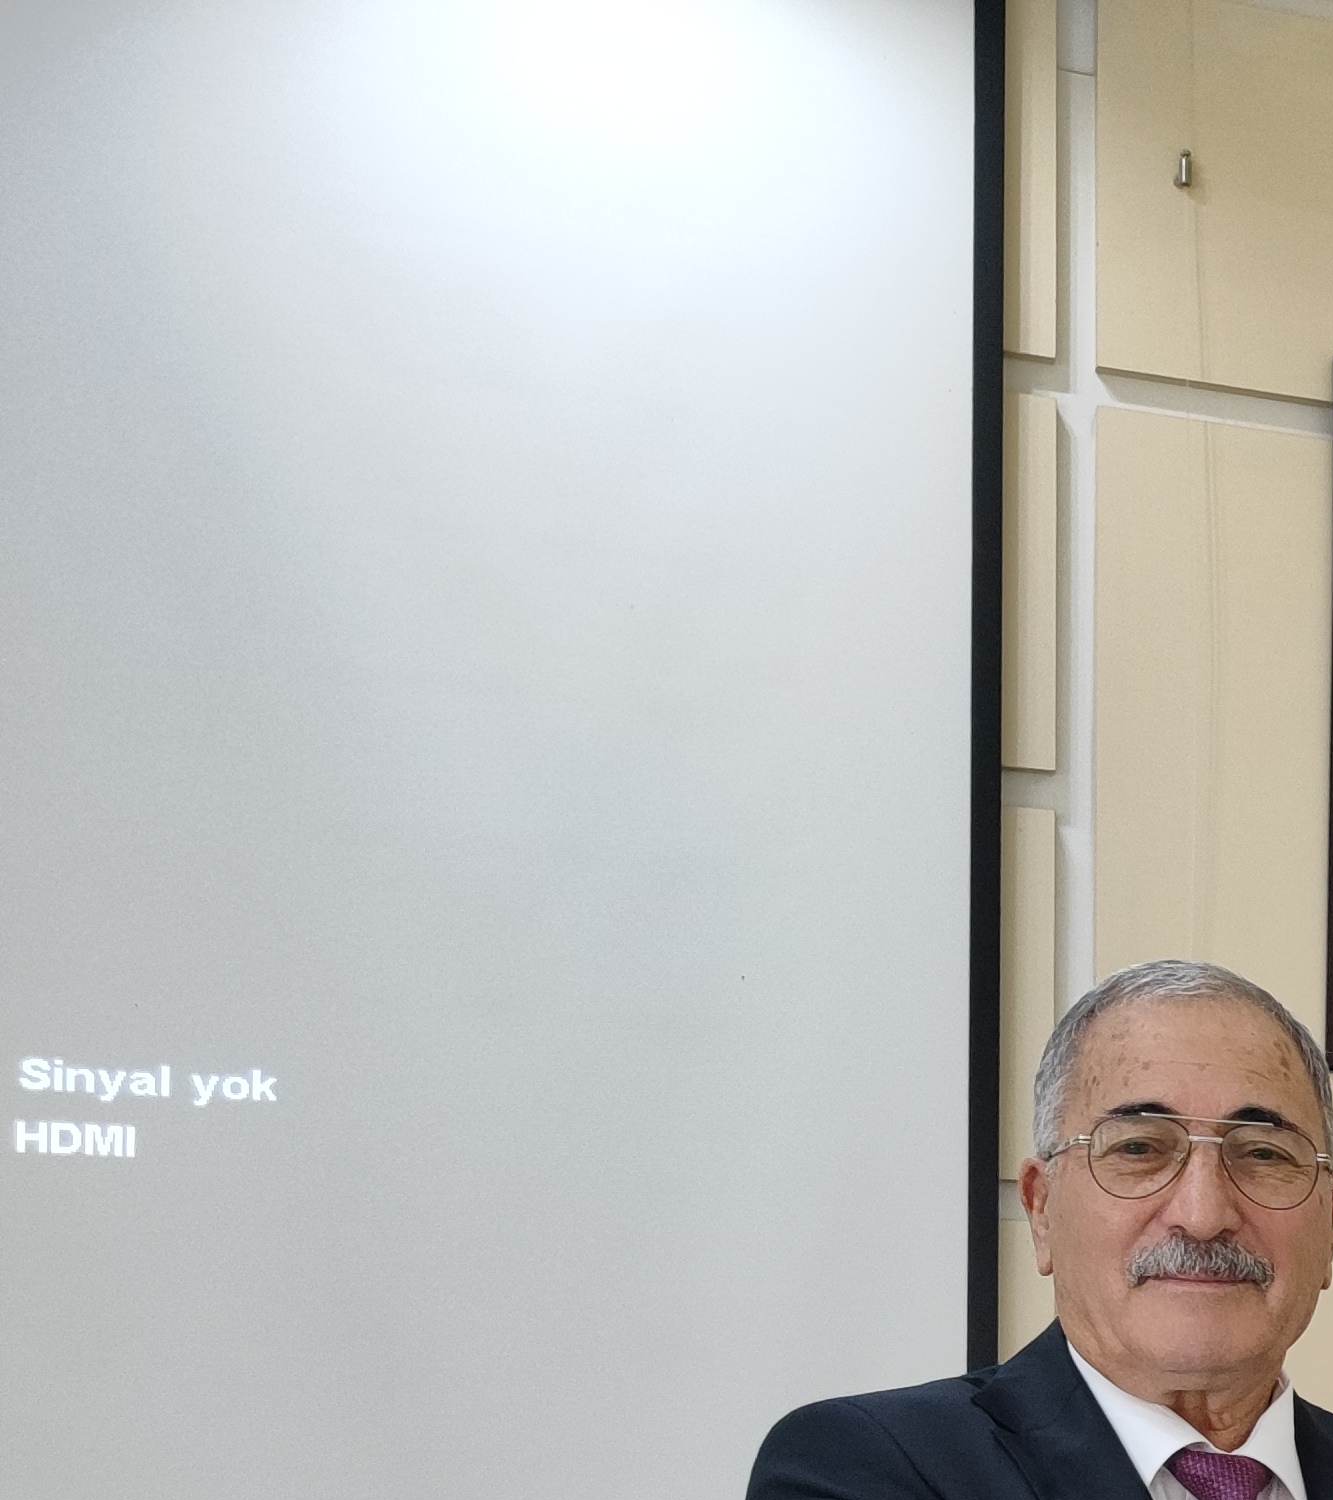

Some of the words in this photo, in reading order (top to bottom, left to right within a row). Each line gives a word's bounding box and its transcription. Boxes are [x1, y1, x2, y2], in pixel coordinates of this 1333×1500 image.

[19, 1057, 171, 1102] Sinyal
[190, 1068, 278, 1107] yok
[14, 1120, 137, 1158] HDMI
